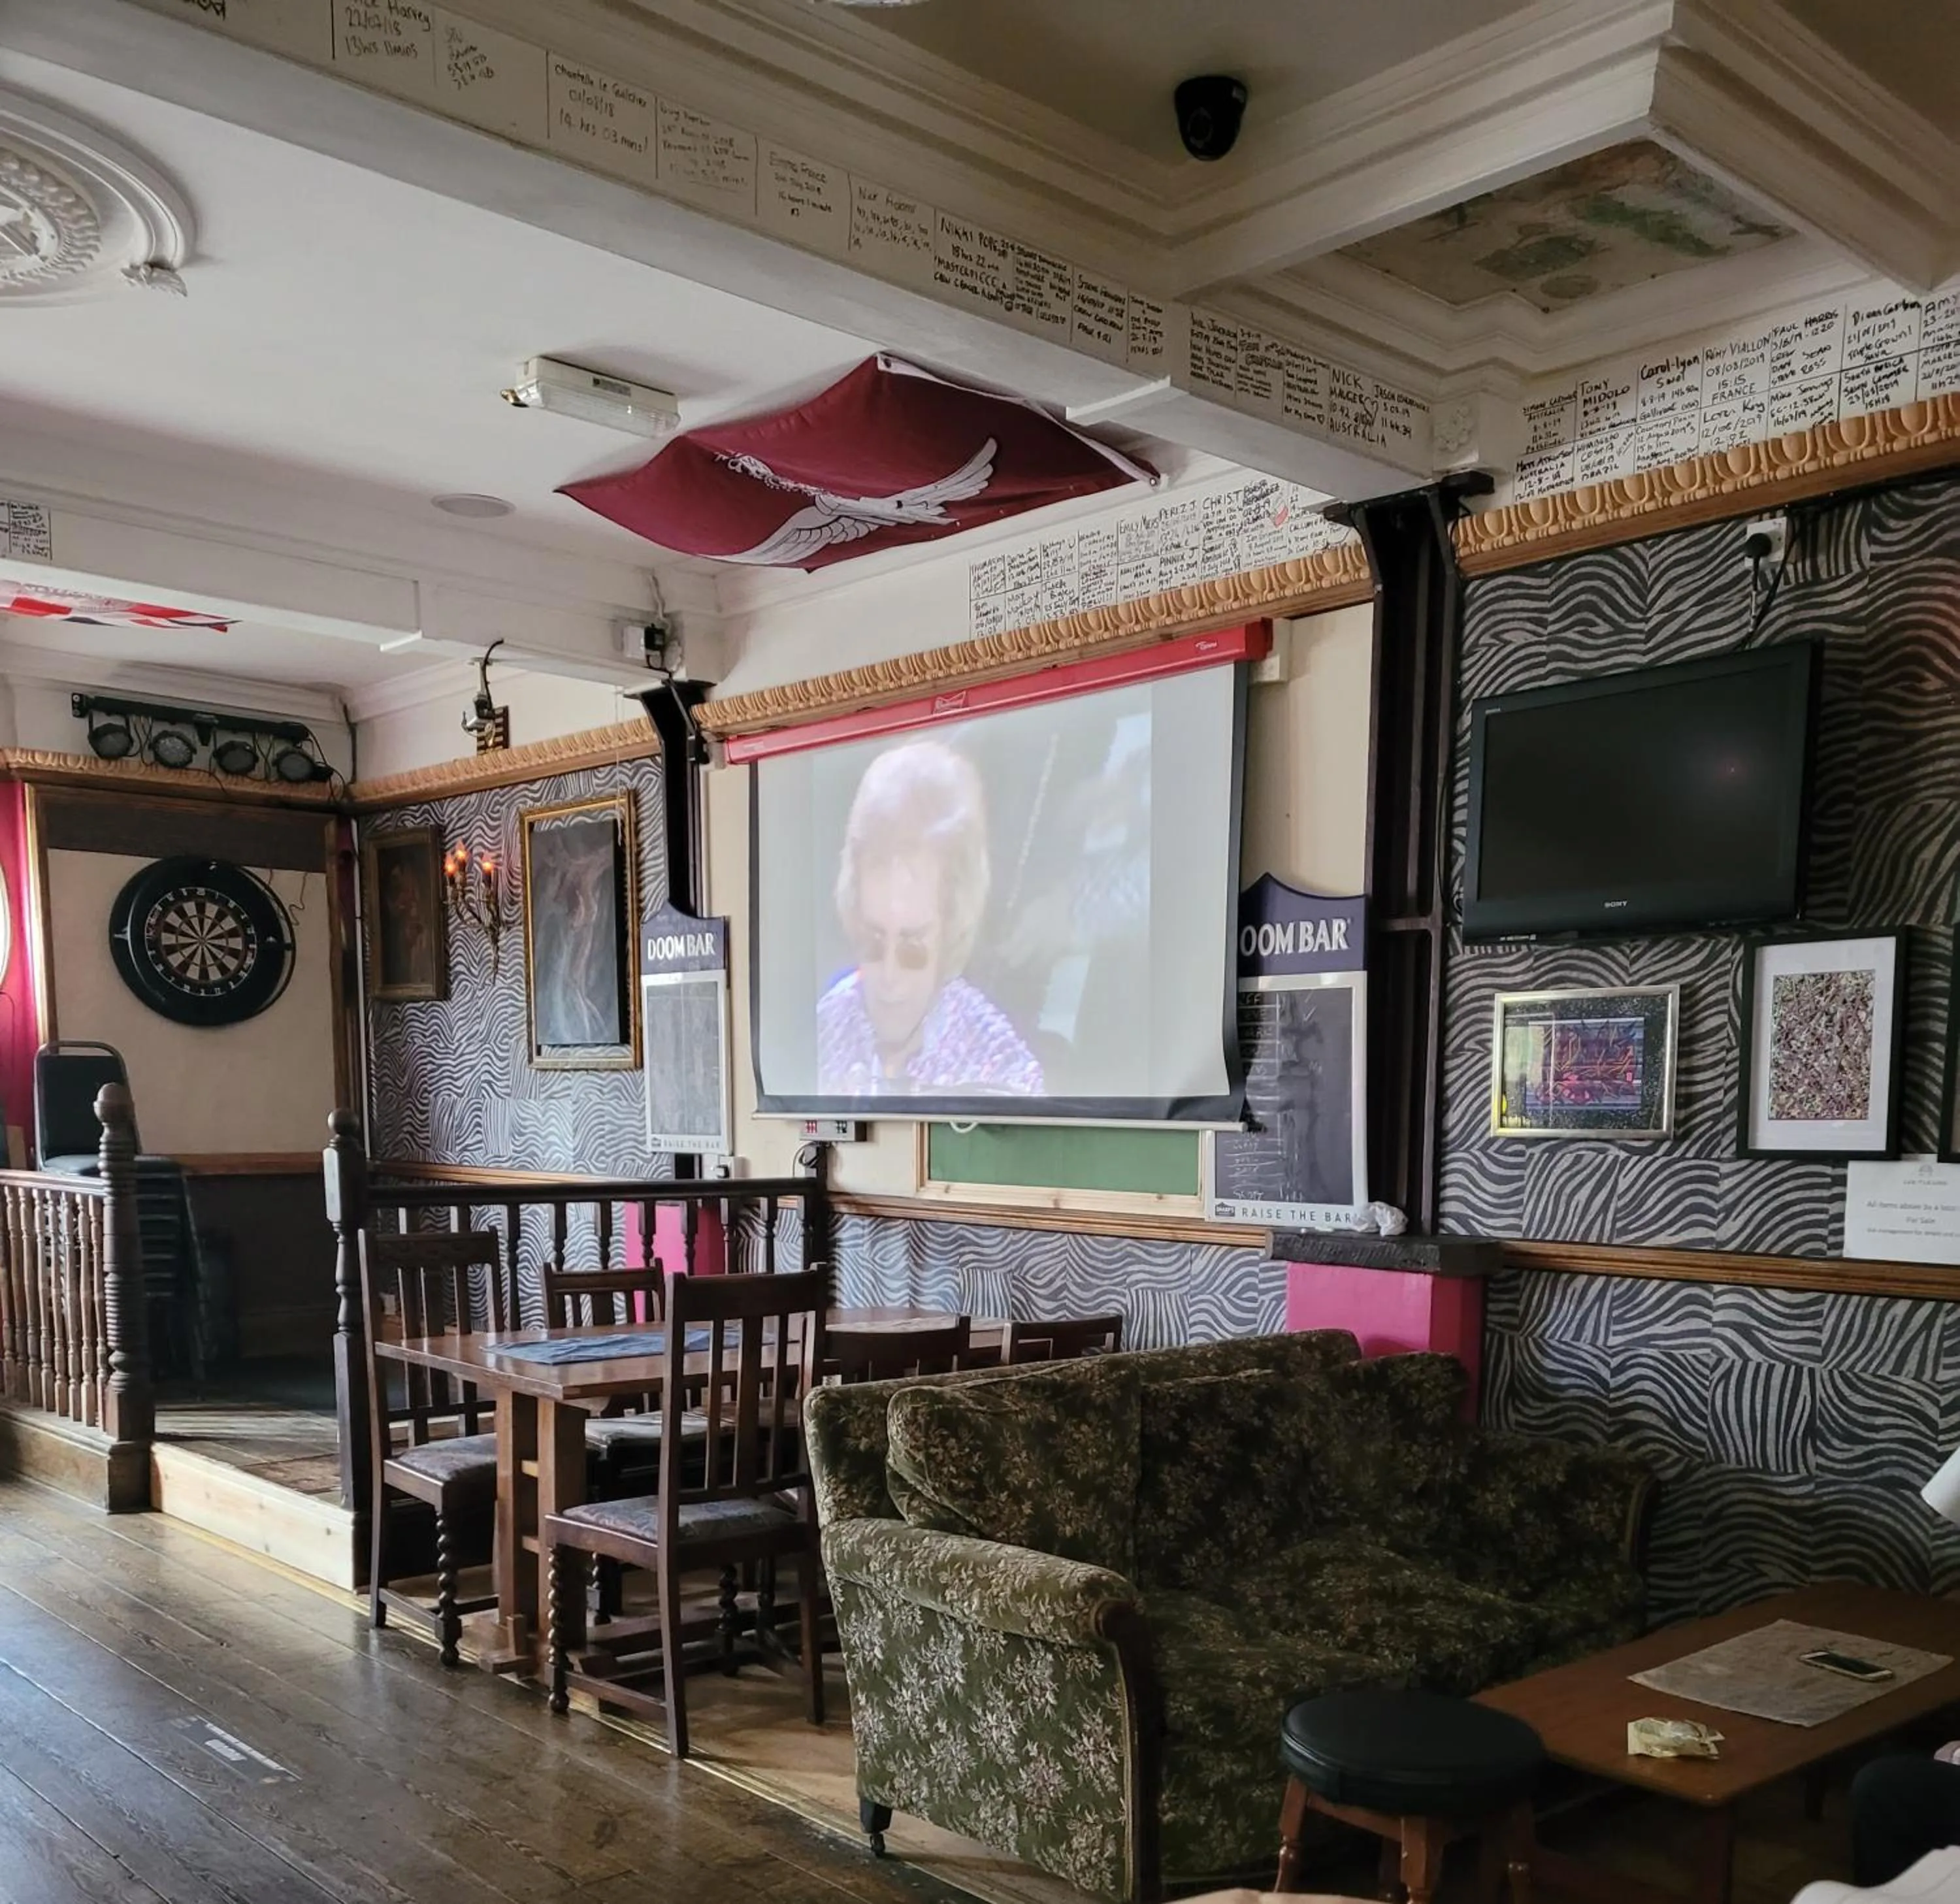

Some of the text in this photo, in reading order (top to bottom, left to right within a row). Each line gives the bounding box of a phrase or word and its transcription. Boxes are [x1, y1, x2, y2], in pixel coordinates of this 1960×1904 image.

[1712, 382, 1756, 405] FRANCE
[647, 932, 717, 961] DOOM BAR
[1240, 917, 1349, 957] OOM BAR
[1241, 1207, 1352, 1223] RAISE THE BAR
